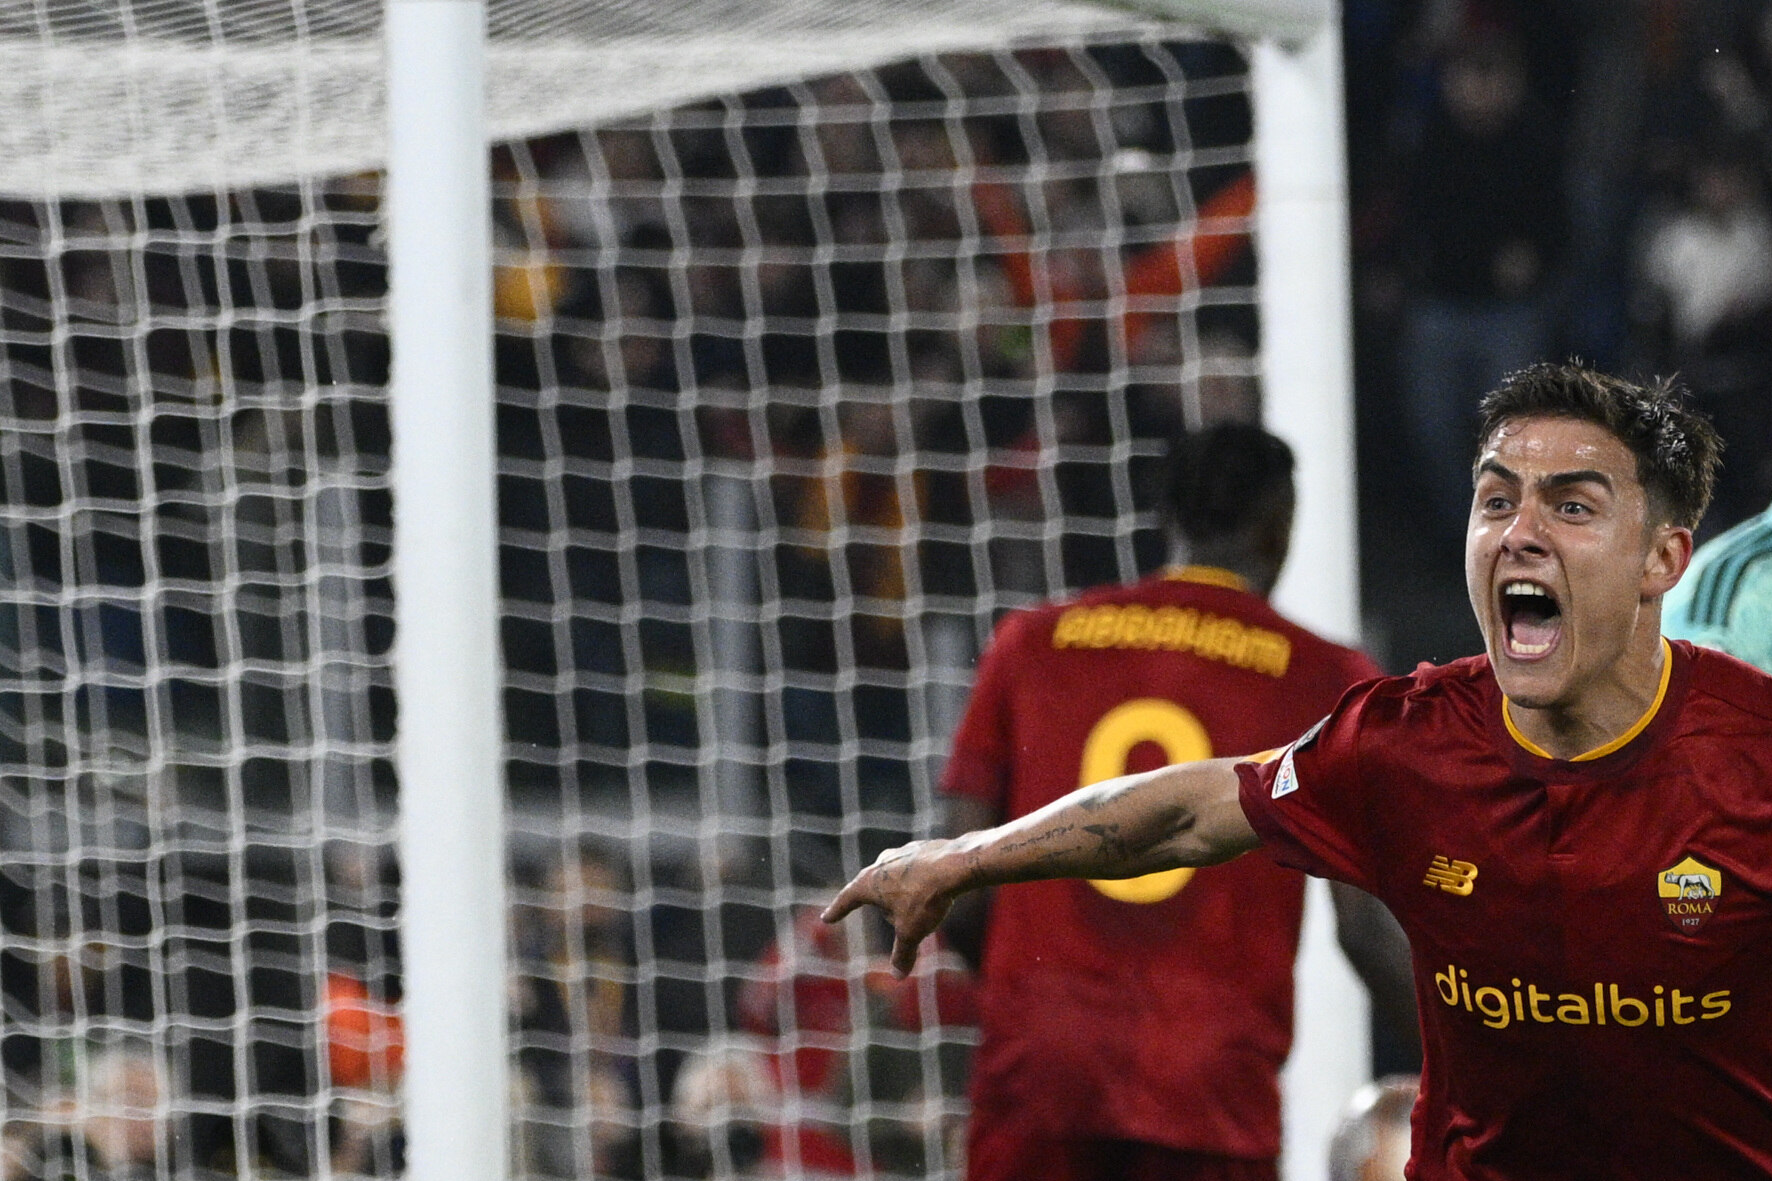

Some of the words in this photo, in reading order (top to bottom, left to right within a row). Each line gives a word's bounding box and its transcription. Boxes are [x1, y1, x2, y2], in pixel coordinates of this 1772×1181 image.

[1667, 901, 1713, 915] ROMA
[1682, 917, 1700, 926] 1927
[1435, 964, 1731, 1030] digitalbits
